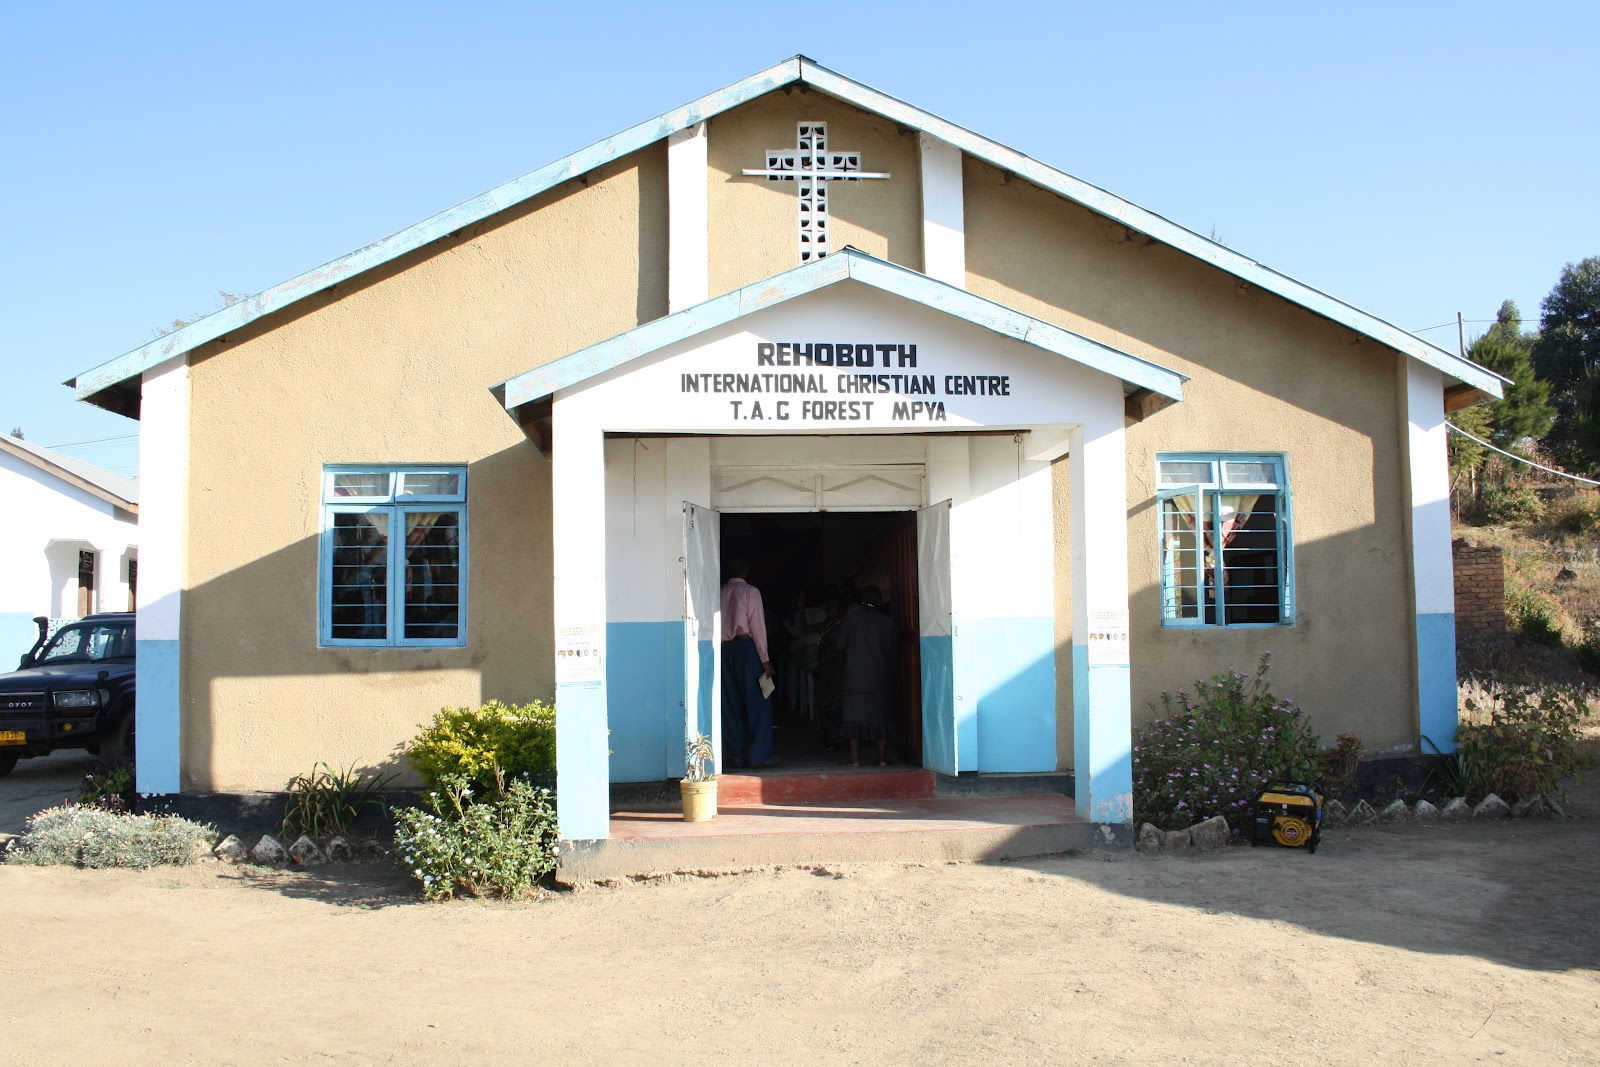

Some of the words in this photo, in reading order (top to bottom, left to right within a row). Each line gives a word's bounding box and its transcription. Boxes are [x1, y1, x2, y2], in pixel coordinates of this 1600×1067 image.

[757, 342, 918, 368] REHOBOTH
[681, 373, 828, 394] INTERNATIONAL
[837, 374, 936, 395] CHRISTIAN
[944, 375, 1011, 397] CENTRE
[802, 400, 874, 421] FOREST
[892, 401, 947, 422] MPYA
